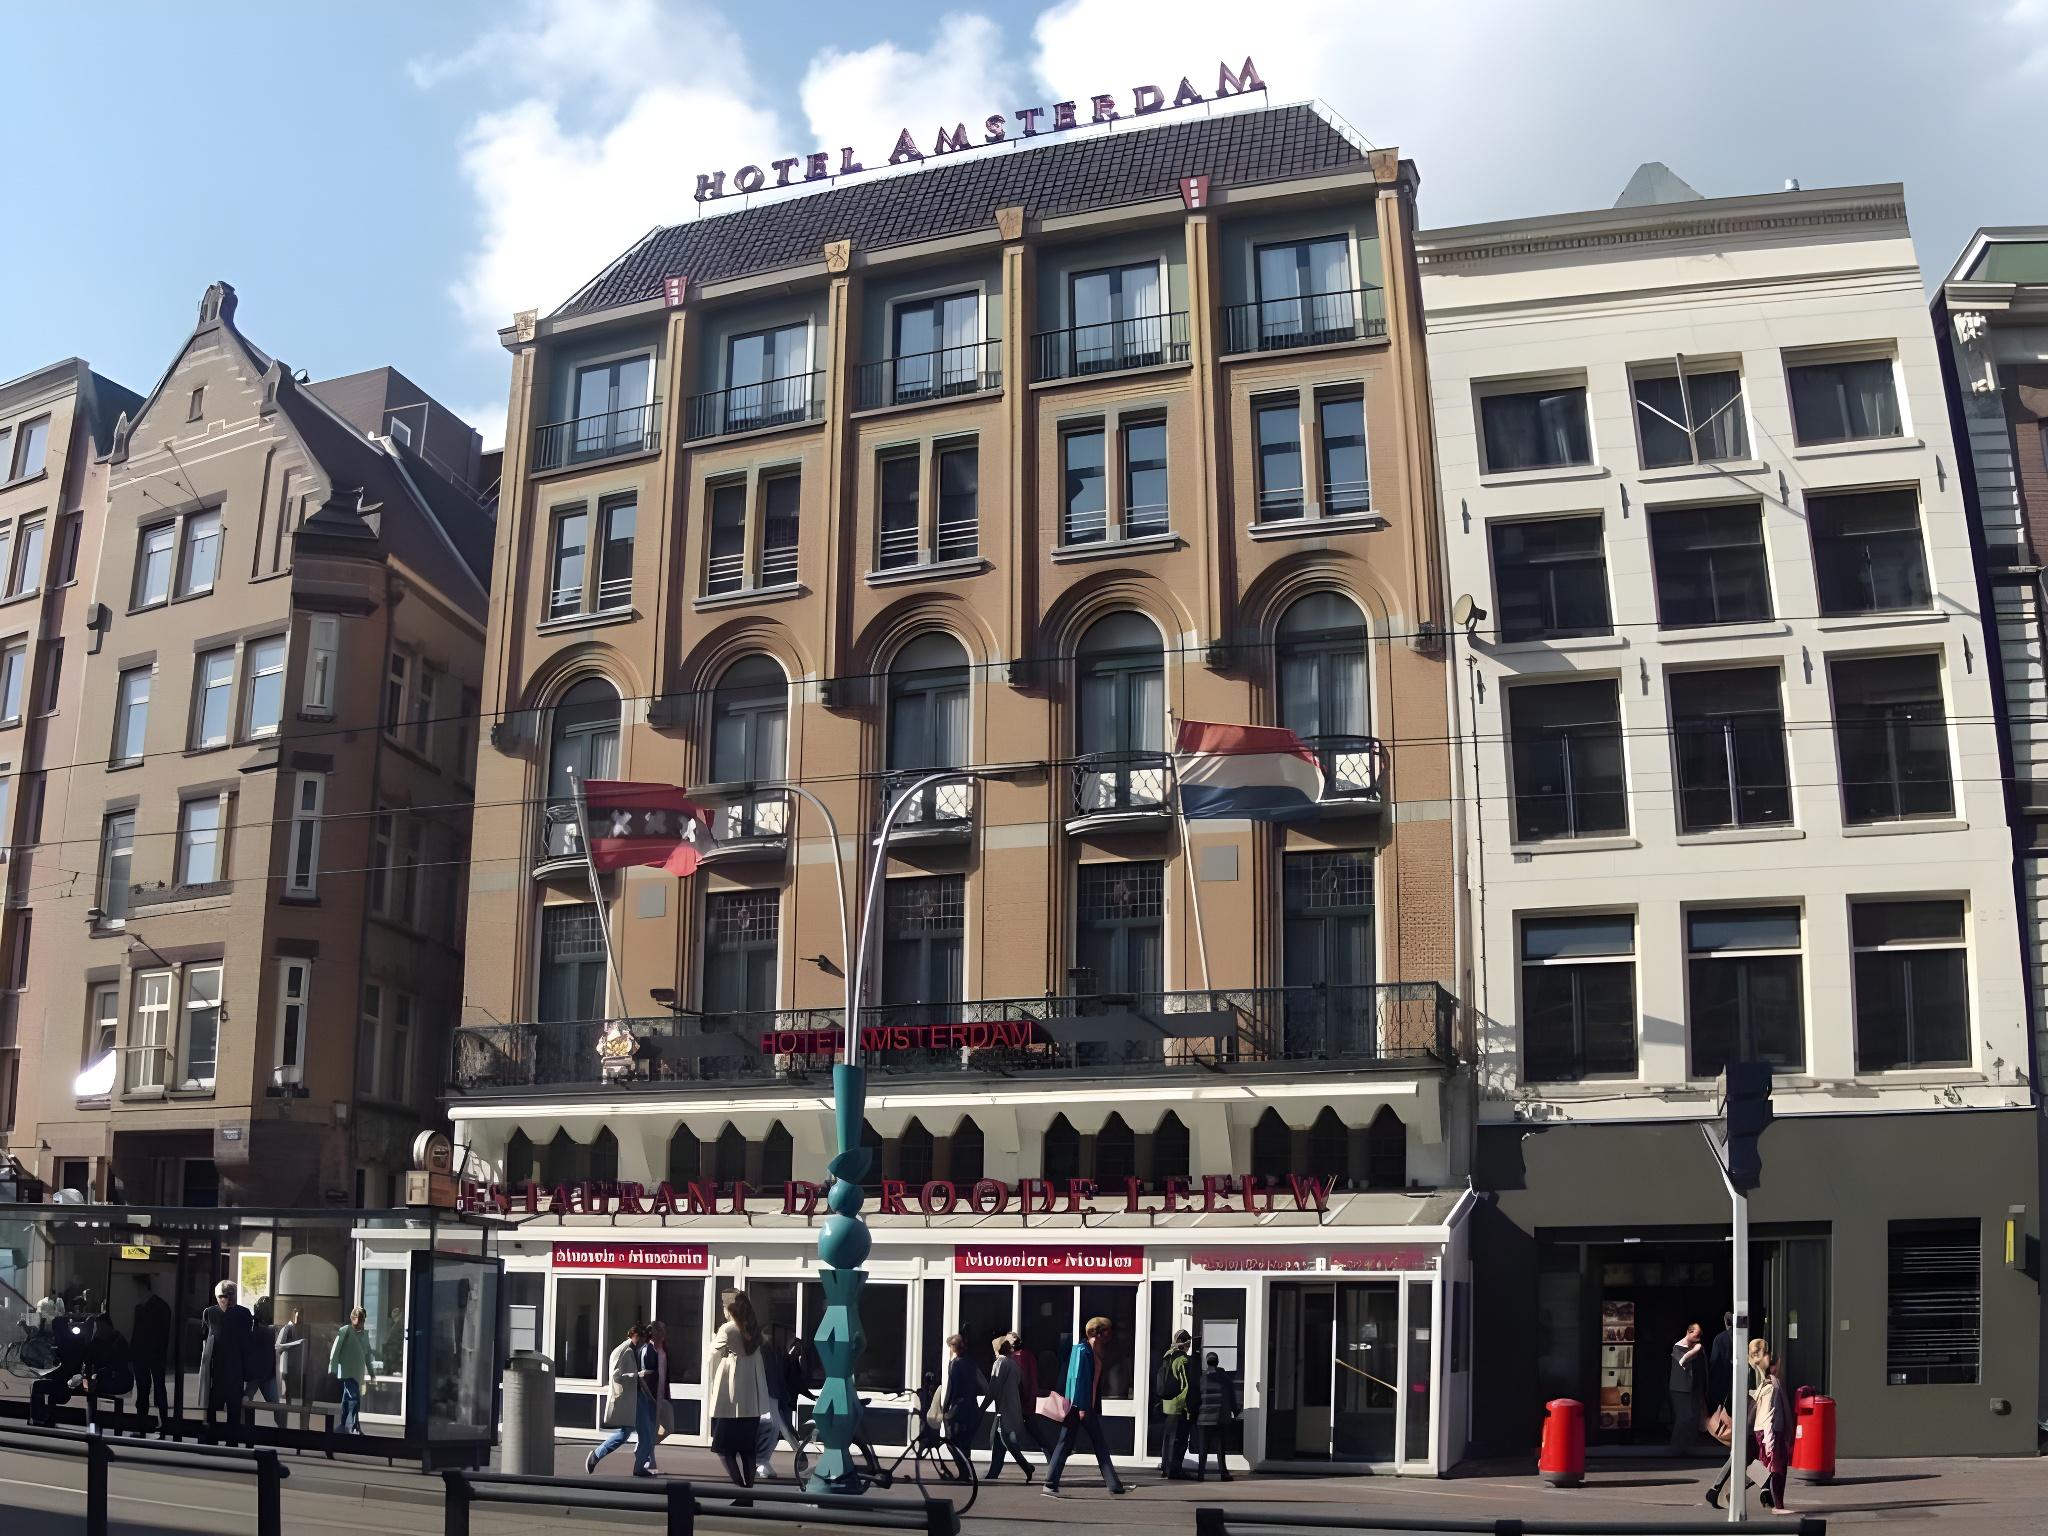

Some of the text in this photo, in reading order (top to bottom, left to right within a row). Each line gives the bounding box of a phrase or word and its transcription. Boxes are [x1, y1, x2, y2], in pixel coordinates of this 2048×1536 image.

[694, 55, 1266, 202] HOTEL AMSTERDAM
[880, 1178, 1099, 1215] ROODE
